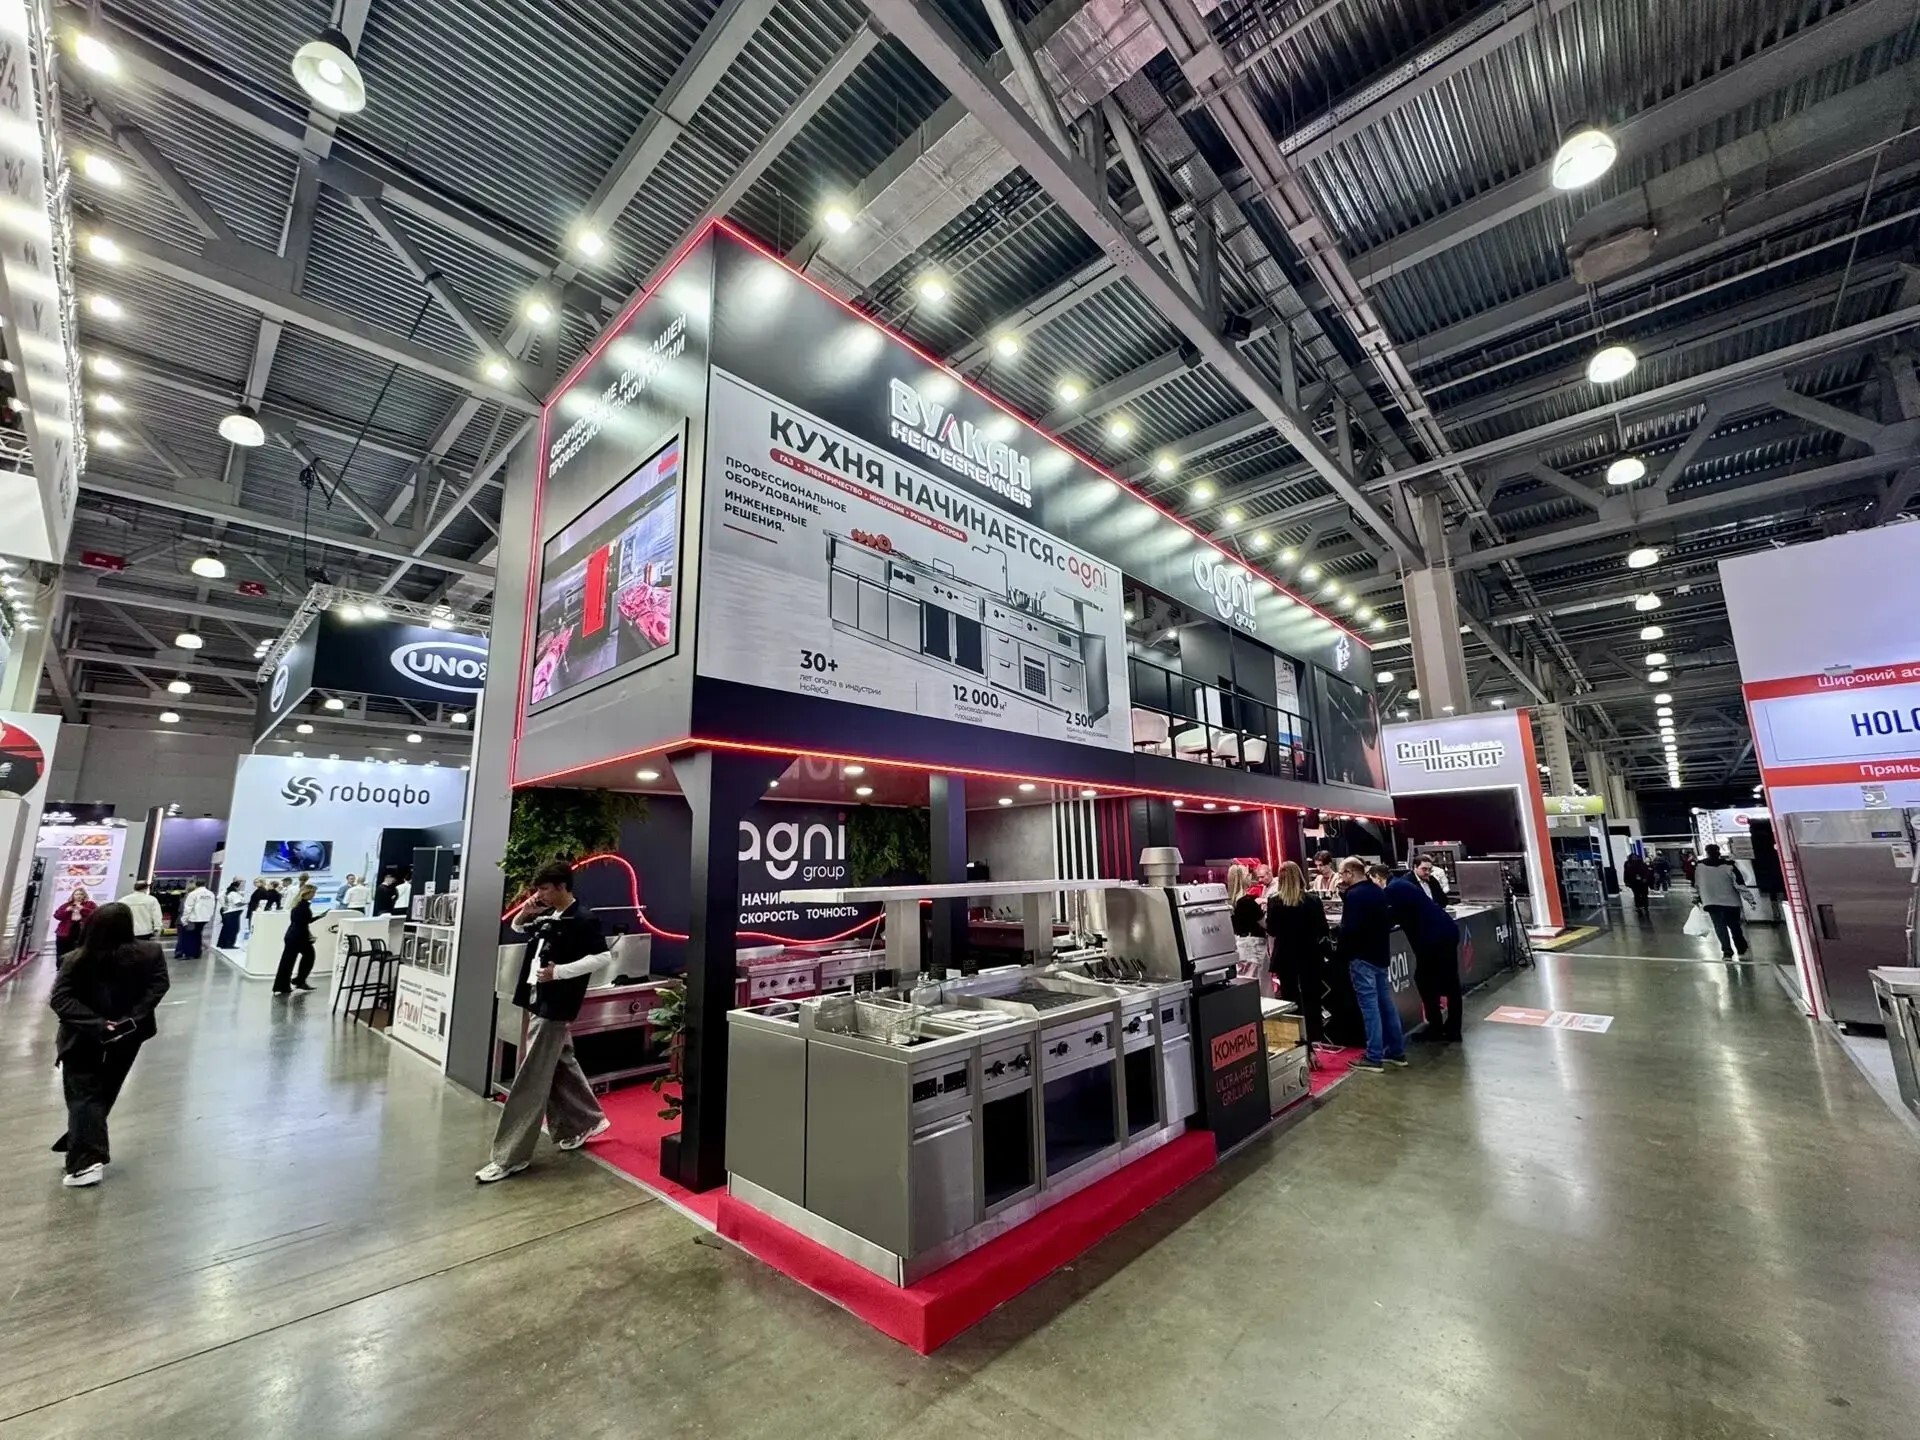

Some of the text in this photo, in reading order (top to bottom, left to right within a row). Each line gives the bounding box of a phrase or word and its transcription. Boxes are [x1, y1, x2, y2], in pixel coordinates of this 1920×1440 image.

[726, 456, 847, 513] ПРОФЕССИОНАЛЬНОЕ
[779, 454, 794, 465] ГАЗ
[803, 464, 863, 496] ЭЛЕКТРИЧЕСТВО
[725, 470, 822, 515] ОБОРУДОВАНИЕ.
[770, 411, 884, 489] КУХНЯ
[895, 471, 1054, 567] НАЧИНАЕТСЯ
[1068, 556, 1108, 589] agni
[724, 503, 785, 532] РЕШЕНИЯ.
[725, 489, 808, 527] ИНЖЕНЕРНЫЕ
[1192, 552, 1256, 619] agni
[800, 649, 838, 672] 30+
[1817, 669, 1896, 688] Широкий
[953, 684, 967, 702] 12
[971, 689, 999, 709] 000
[1065, 711, 1094, 728] 2 500
[1396, 739, 1441, 759] Grill
[330, 782, 430, 807] roboqbo
[738, 812, 846, 881] agni
[803, 864, 845, 881] group
[741, 891, 797, 907] НАЧИ
[739, 905, 859, 924] СКОРОСТЬ ТОЧНОСТЬ
